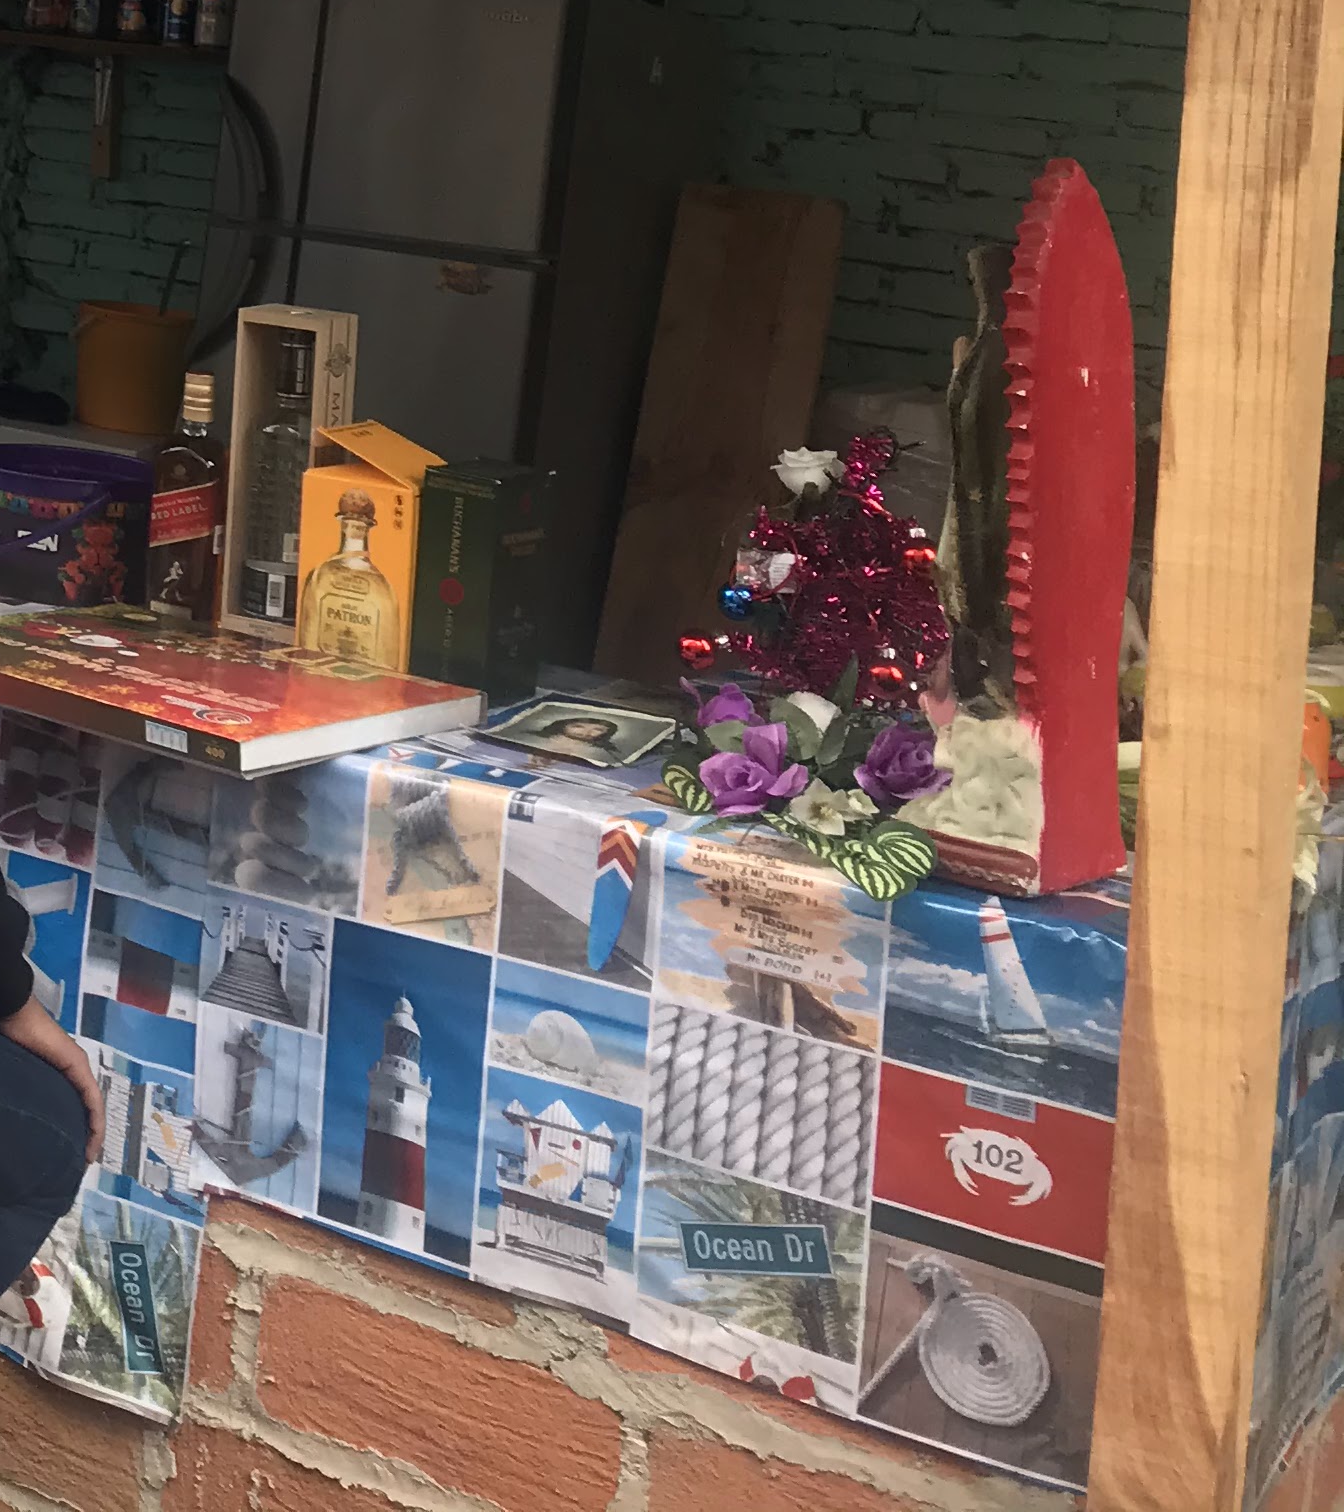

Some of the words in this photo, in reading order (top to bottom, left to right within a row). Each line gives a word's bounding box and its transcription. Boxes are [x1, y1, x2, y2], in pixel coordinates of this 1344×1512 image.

[971, 1138, 1025, 1175] 102
[692, 1229, 775, 1263] Ocean
[785, 1232, 815, 1264] Dr
[118, 1251, 146, 1325] Ocean
[134, 1333, 156, 1363] Dr
